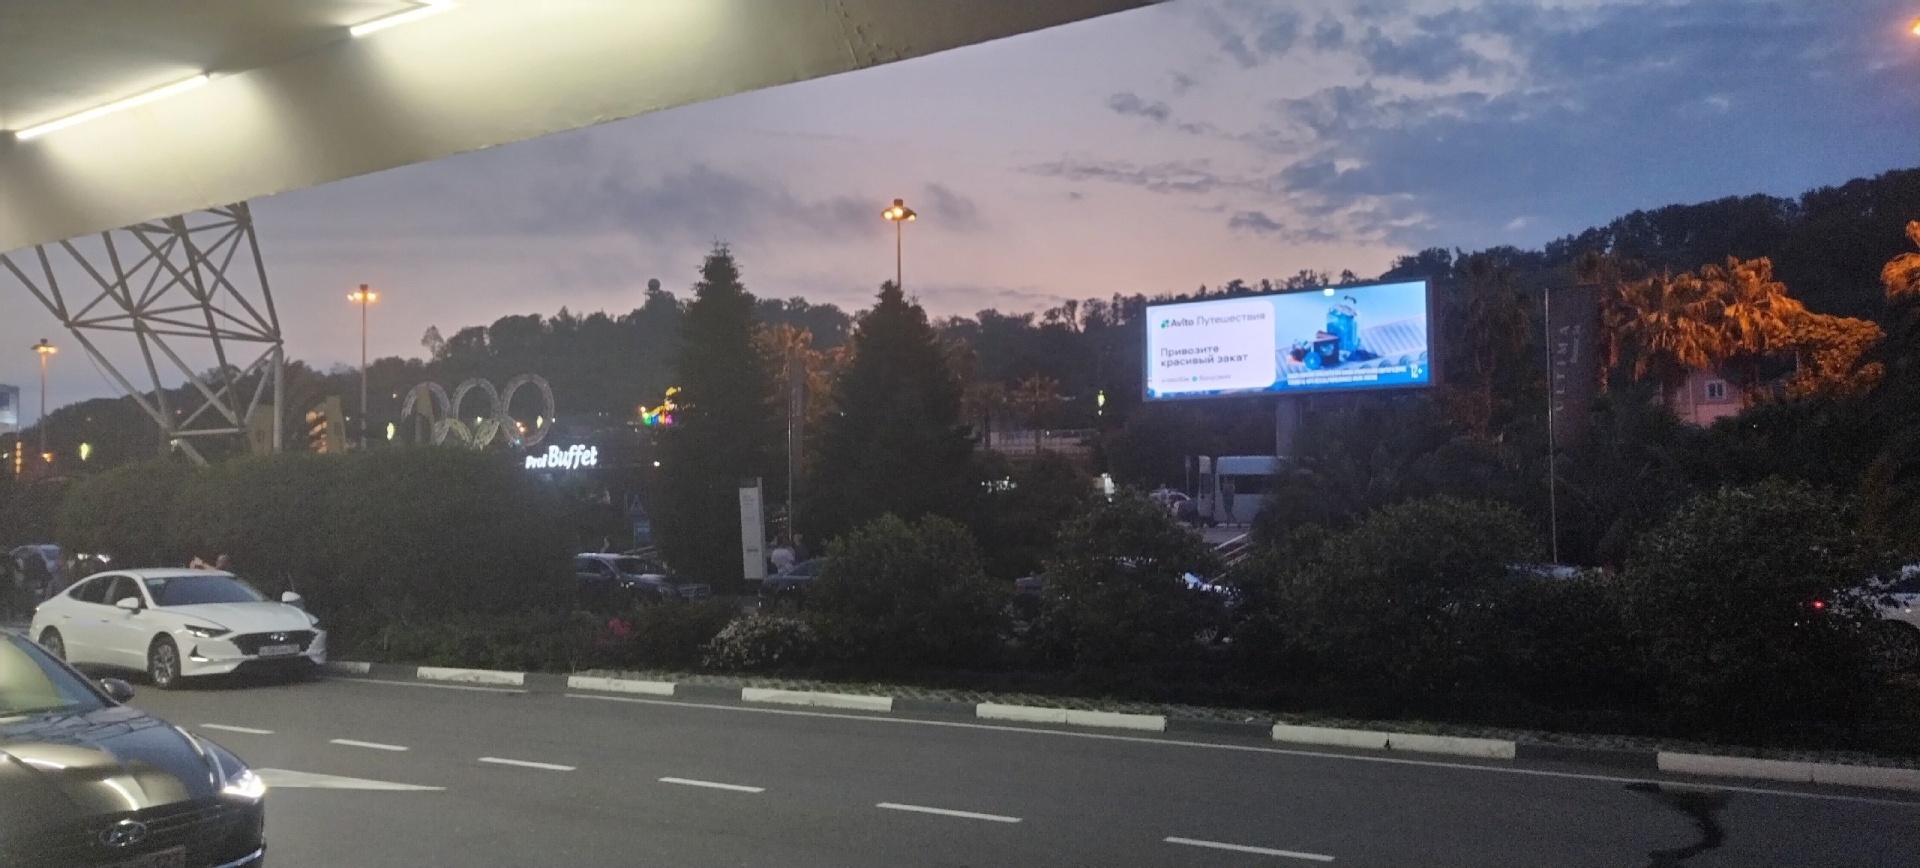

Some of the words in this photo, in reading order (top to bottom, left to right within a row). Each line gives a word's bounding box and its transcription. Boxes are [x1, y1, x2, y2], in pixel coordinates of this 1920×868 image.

[1170, 318, 1194, 328] Avito
[1196, 313, 1266, 326] Путешествия
[1160, 346, 1219, 357] Привозите
[1160, 355, 1214, 368] красивый
[1217, 354, 1248, 364] закат
[1410, 364, 1422, 378] 12+
[548, 444, 598, 470] Buffet
